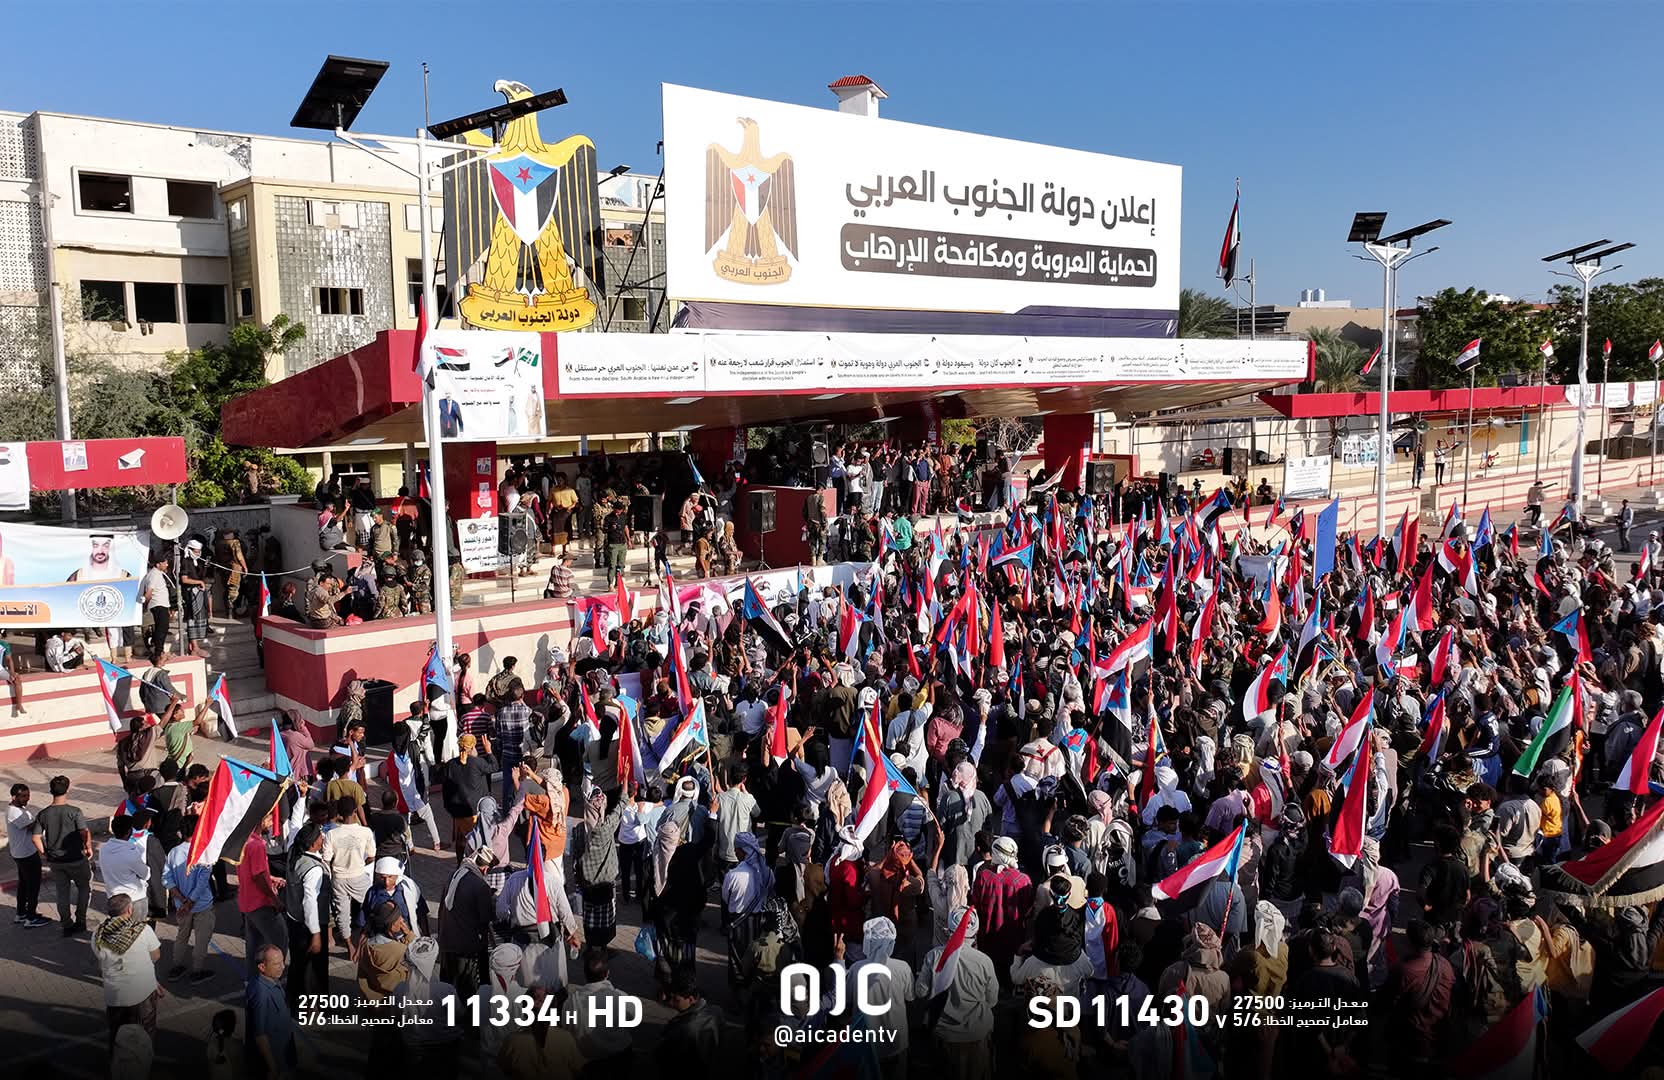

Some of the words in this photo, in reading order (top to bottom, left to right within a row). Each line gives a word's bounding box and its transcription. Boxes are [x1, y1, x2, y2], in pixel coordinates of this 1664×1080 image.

[845, 169, 935, 218] العربي
[943, 178, 1034, 221] الجنوب
[1041, 181, 1095, 226] دولة
[1101, 196, 1156, 237] إعلان
[845, 232, 929, 272] الإرهاب
[933, 236, 1026, 276] ومكافحة
[1031, 244, 1095, 278] العروبة
[1098, 250, 1154, 283] لحماية
[720, 264, 751, 277] العربي
[753, 266, 785, 280] الجنوب
[479, 309, 516, 323] العربي
[518, 309, 555, 326] الجنوب
[557, 308, 580, 323] دولة
[625, 363, 647, 373] الجنوب
